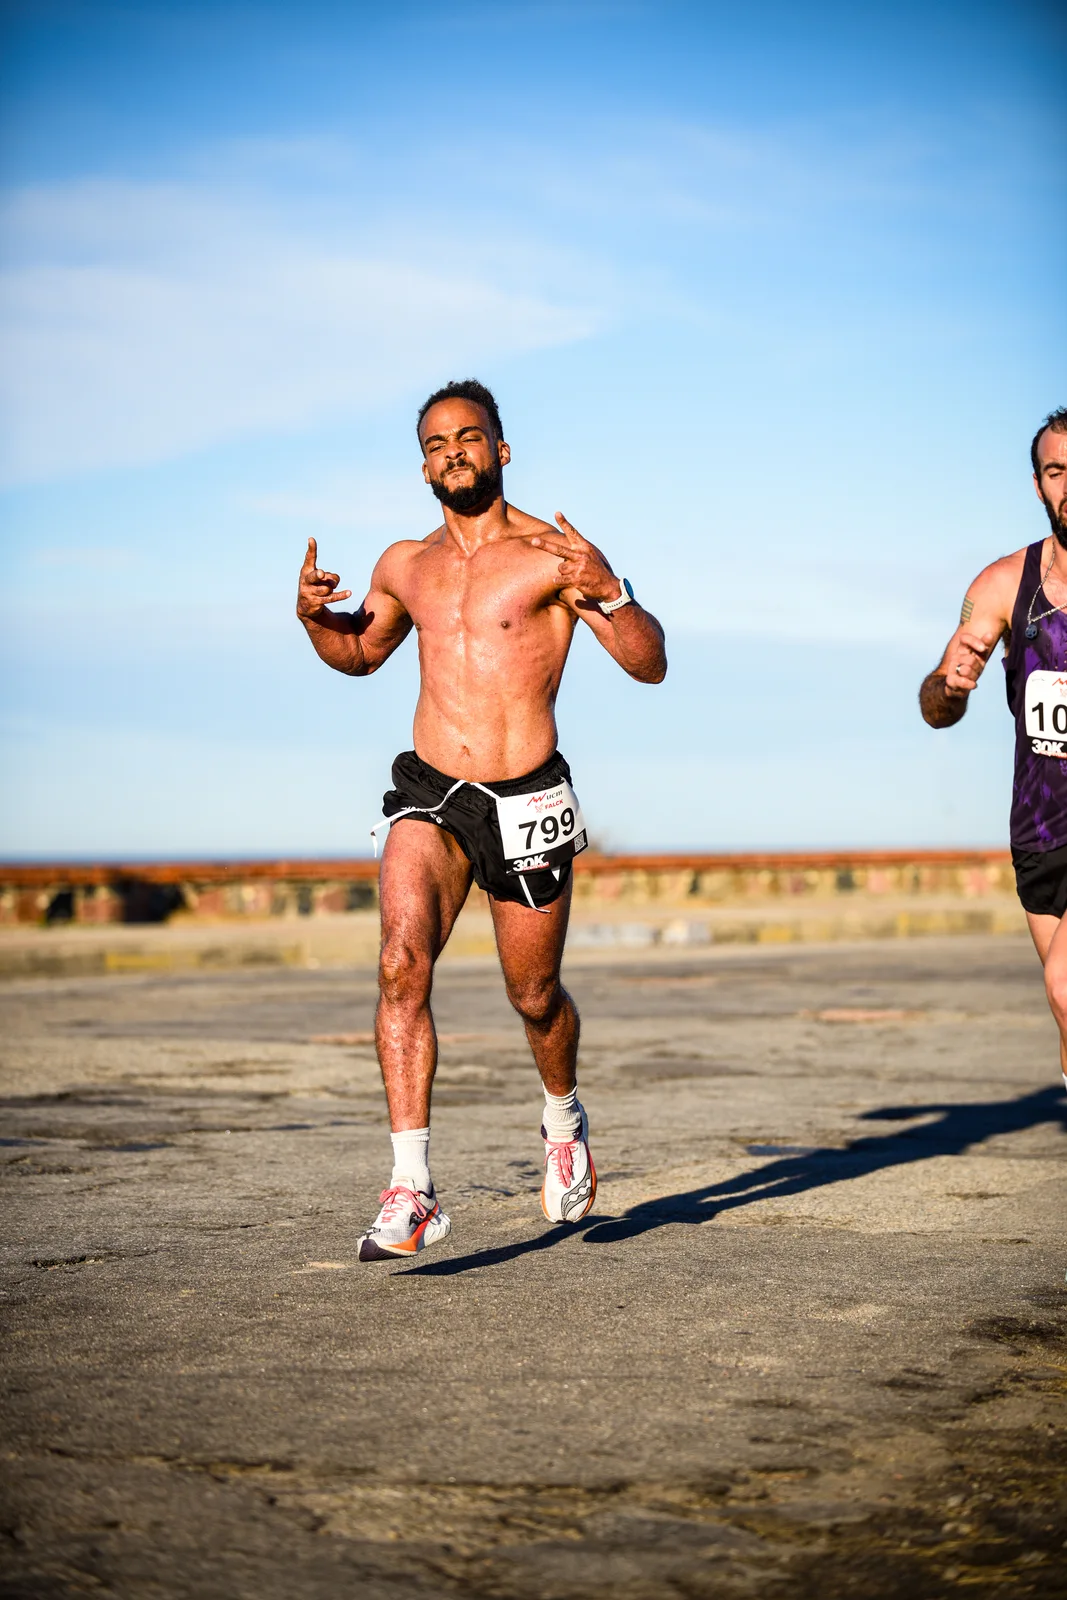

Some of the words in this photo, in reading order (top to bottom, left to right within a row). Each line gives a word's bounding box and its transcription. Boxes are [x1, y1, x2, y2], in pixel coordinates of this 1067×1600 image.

[1031, 739, 1064, 756] 30K
[545, 799, 564, 810] FALCK
[518, 807, 575, 850] 799
[512, 853, 546, 872] 30K
